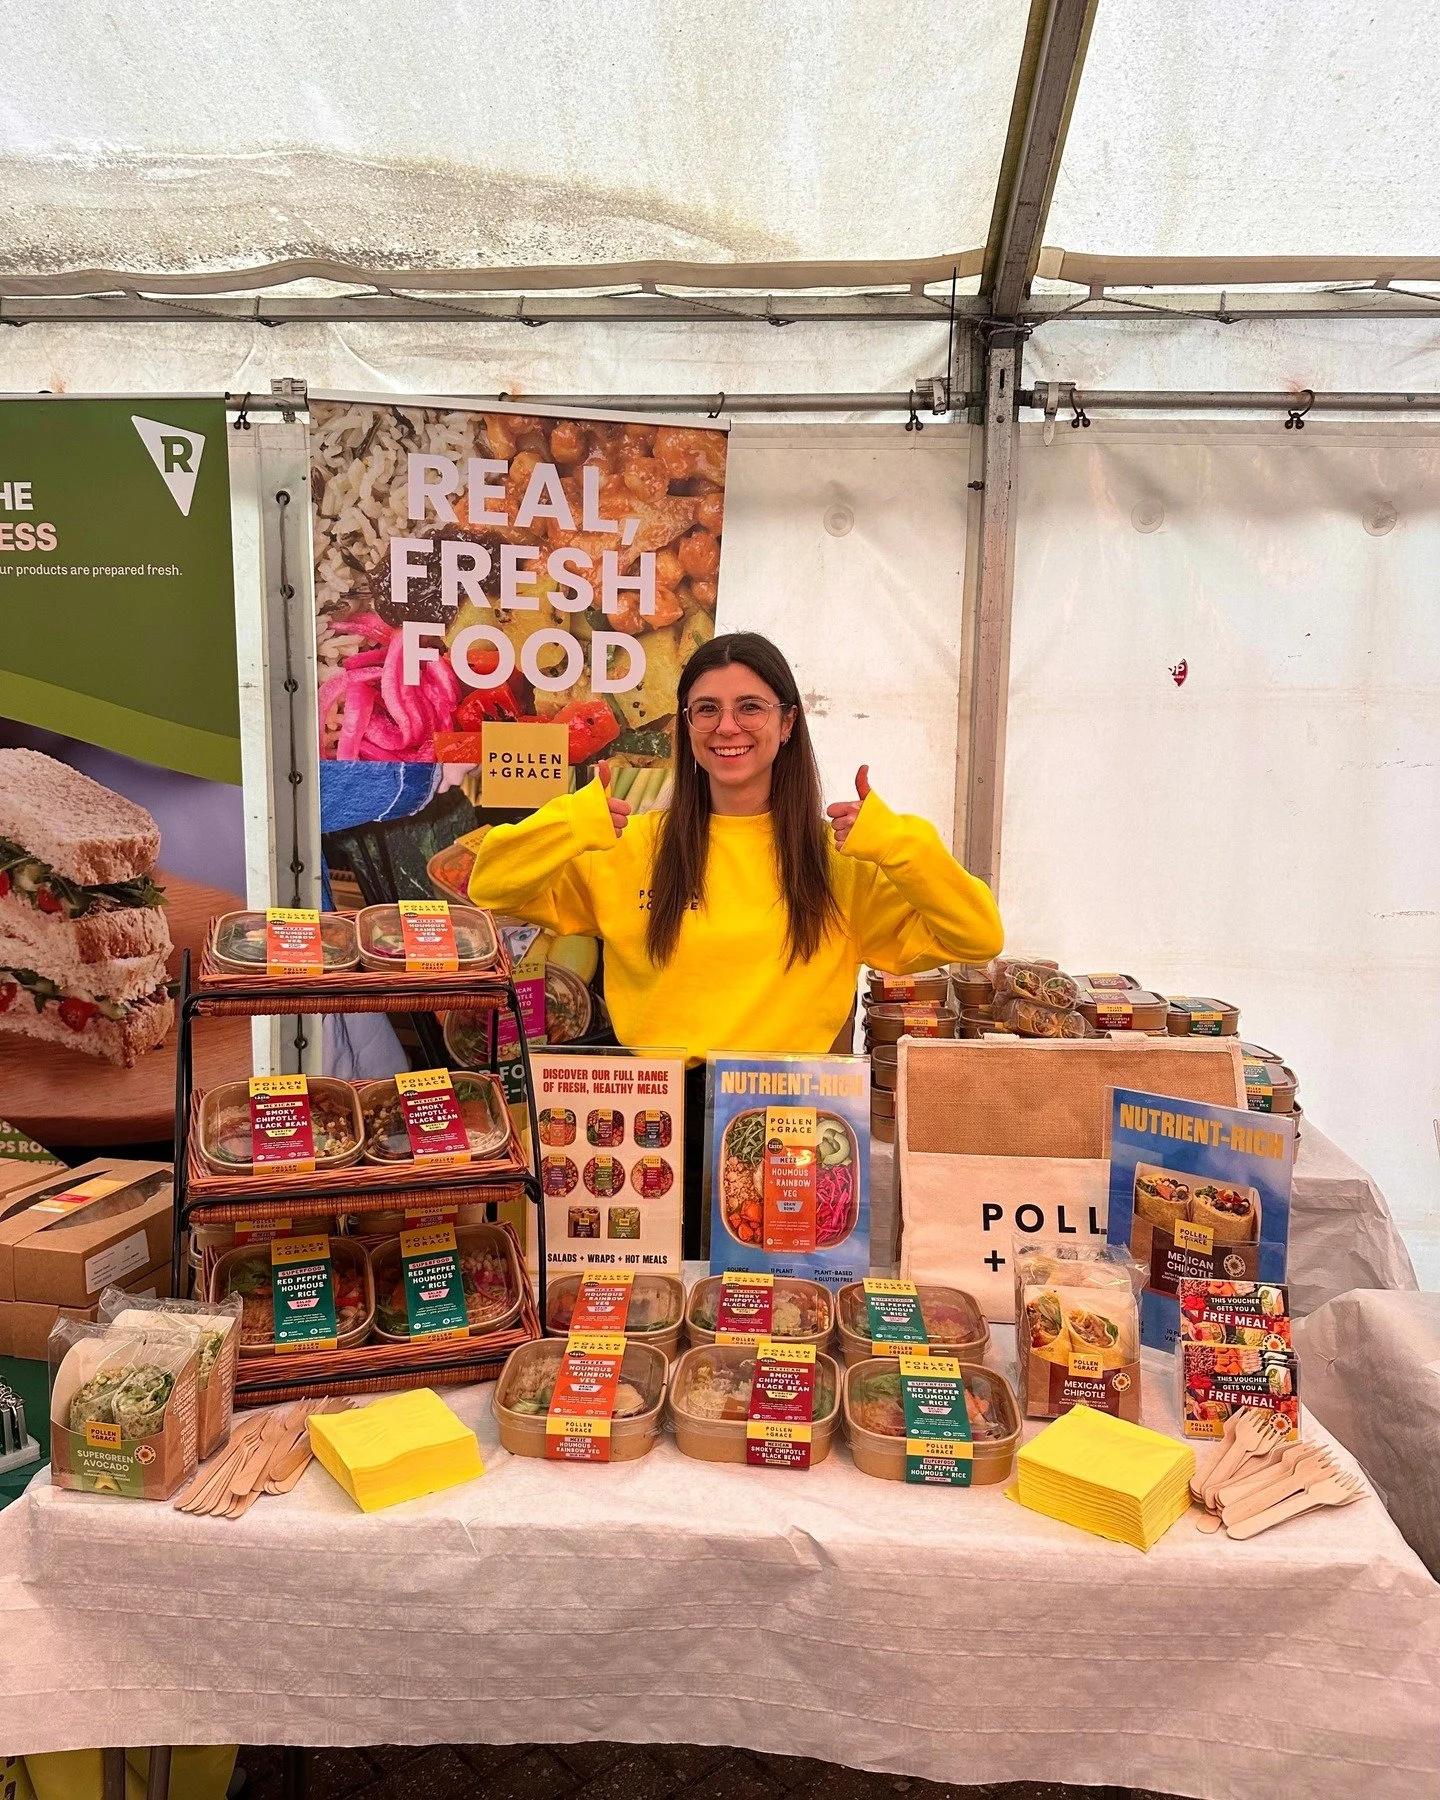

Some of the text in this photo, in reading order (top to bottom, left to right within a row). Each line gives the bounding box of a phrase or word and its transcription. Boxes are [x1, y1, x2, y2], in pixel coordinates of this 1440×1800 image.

[160, 435, 193, 473] R
[407, 452, 640, 545] REAL,
[16, 564, 68, 577] products
[71, 567, 89, 575] are
[92, 564, 144, 577] prepared
[148, 564, 182, 576] fresh.
[390, 537, 656, 616] FRESH
[402, 621, 646, 693] FOOD
[489, 752, 561, 765] POLLEN
[490, 768, 561, 779] +GRACE
[543, 1069, 668, 1081] DISCOVER OUR FULL RANGE
[543, 1082, 668, 1095] OF FRESH, HEALTHY MEALS
[721, 1071, 863, 1098] NUTRIENT-RICH
[409, 1110, 447, 1118] CHIPOTLE
[771, 1126, 812, 1134] +GRACE
[1119, 1103, 1285, 1160] NUTRIENT-RICH
[772, 1168, 808, 1176] HOUMOUS
[406, 1232, 450, 1243] POLLEN
[1180, 1229, 1207, 1239] POLLEN
[277, 1242, 324, 1251] POLLEN
[548, 1254, 577, 1263] SALADS
[587, 1254, 615, 1263] WRAPS
[625, 1255, 639, 1264] HOT
[643, 1255, 667, 1264] MEALS
[1168, 1251, 1214, 1270] MEXICAN
[427, 1265, 456, 1275] PEPPER
[1167, 1261, 1214, 1278] CHIPOTLE
[297, 1274, 327, 1282] PEPPER
[413, 1273, 453, 1284] HOUMOUS
[282, 1282, 324, 1292] HOUMOUS
[429, 1281, 447, 1289] RICE
[1203, 1312, 1232, 1324] FREE
[1065, 1380, 1105, 1390] MEXICAN
[1064, 1389, 1105, 1399] CHIPOTLE
[1209, 1391, 1238, 1403] FREE
[77, 1450, 133, 1463] SUPERGREEN
[84, 1460, 129, 1471] AVOCADO
